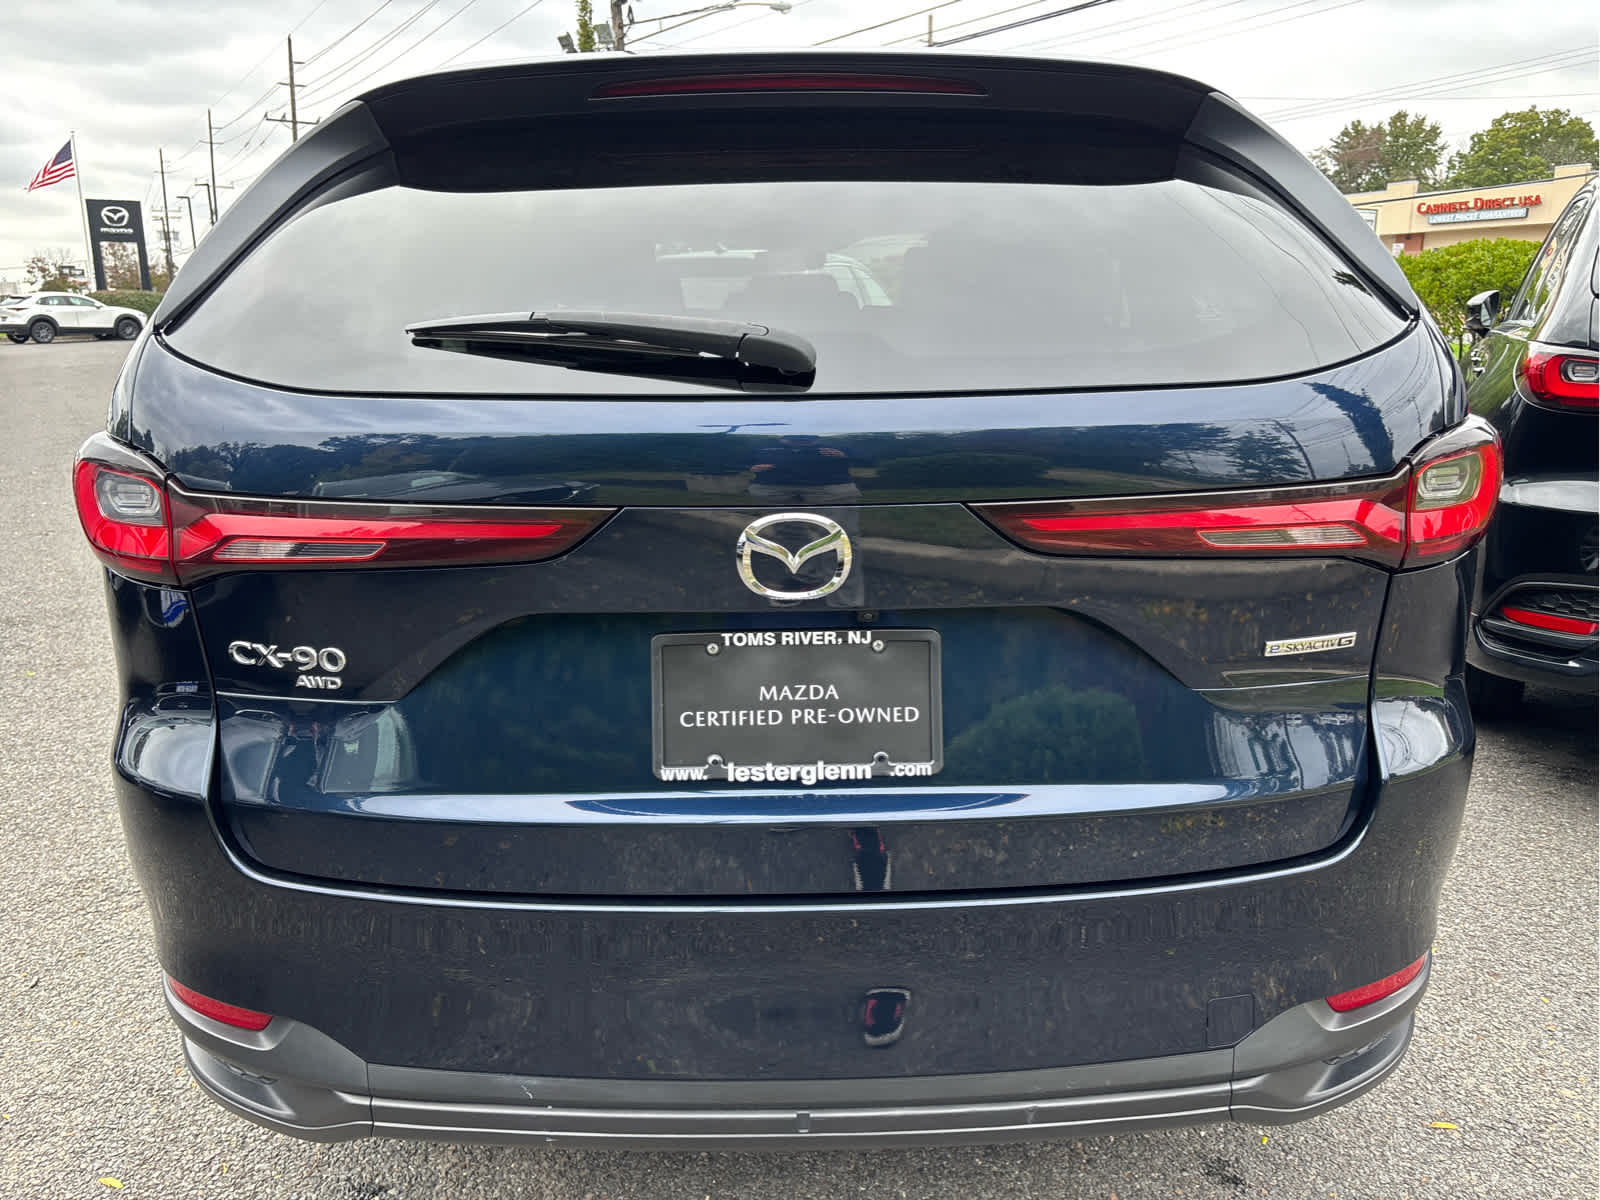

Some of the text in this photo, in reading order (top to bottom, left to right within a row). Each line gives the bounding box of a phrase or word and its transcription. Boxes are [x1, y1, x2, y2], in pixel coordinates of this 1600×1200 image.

[1417, 195, 1542, 214] CABINETS DIRECT USA
[721, 631, 872, 647] TOMS RIVER, NJ
[228, 640, 346, 673] CX-90
[296, 674, 342, 690] AWD
[759, 684, 840, 702] MAZDA
[679, 706, 920, 727] CERTIFIED PRE-OWNED
[660, 761, 933, 785] www. lesterglenn .com
